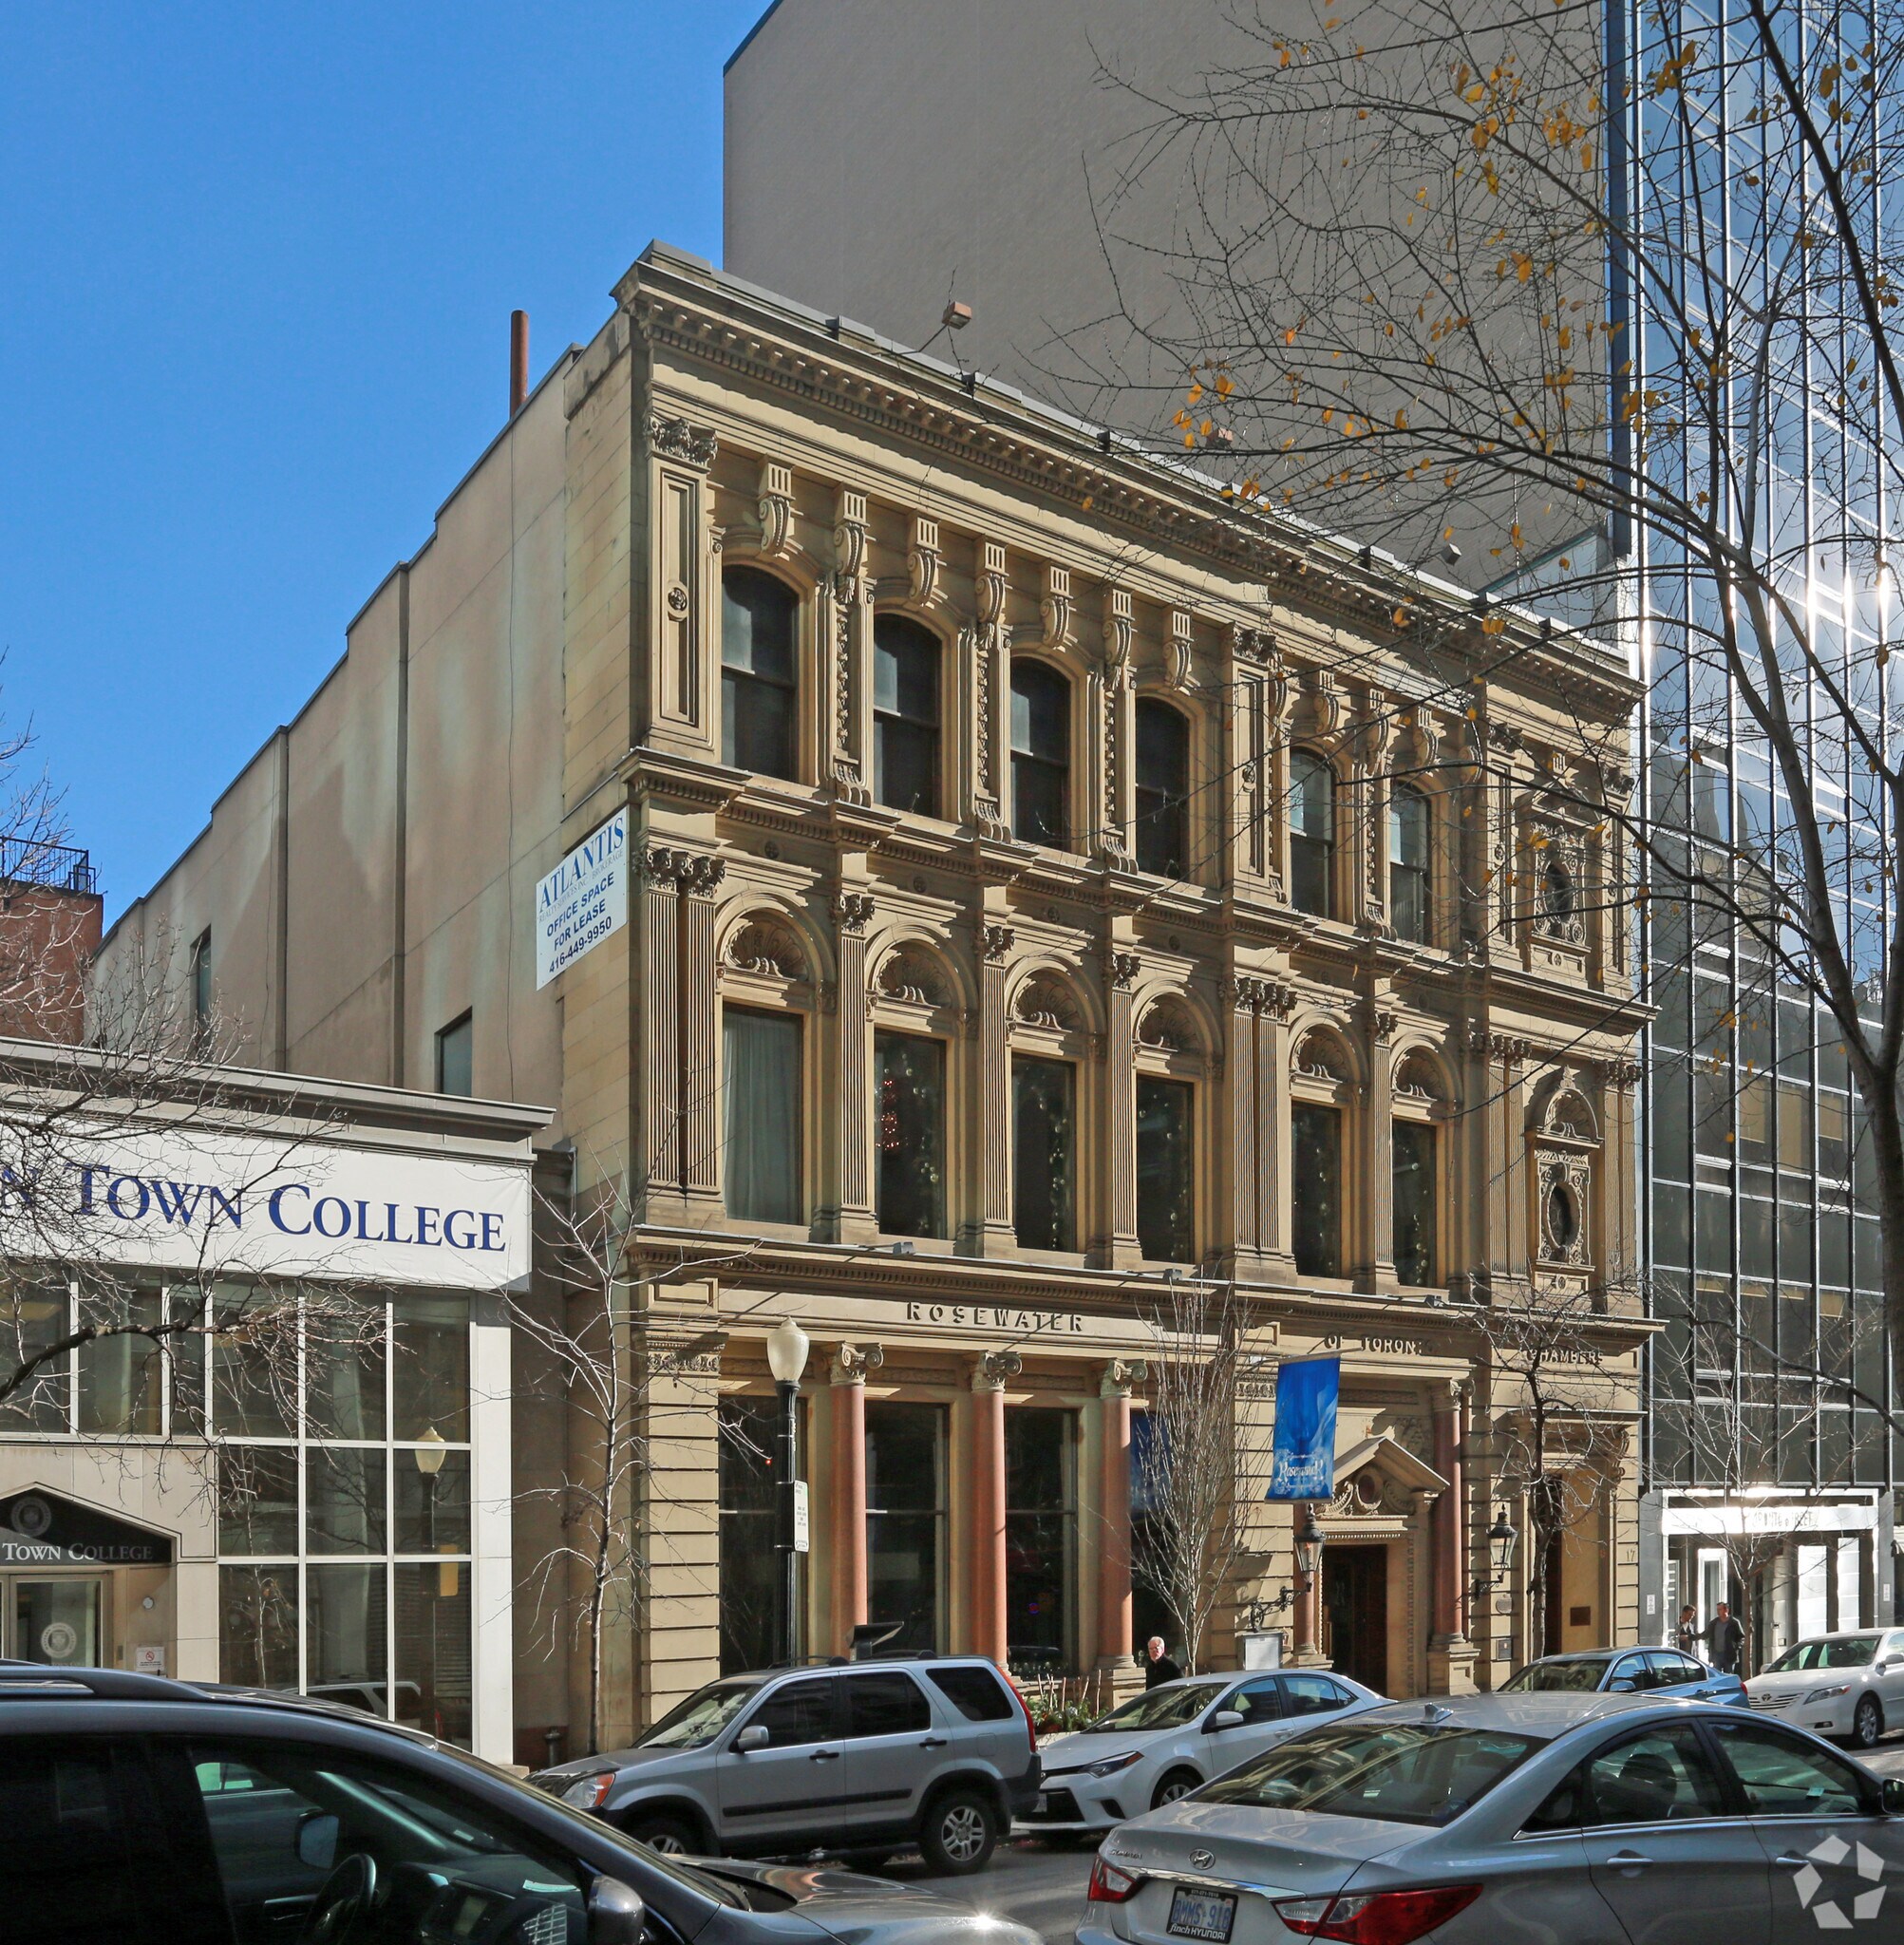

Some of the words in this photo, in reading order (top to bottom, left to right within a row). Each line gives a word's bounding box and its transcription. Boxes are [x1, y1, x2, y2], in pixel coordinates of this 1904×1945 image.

[538, 817, 624, 914] ATLANTIS
[546, 899, 578, 937] OFFICE
[581, 871, 614, 908] SPACE
[554, 926, 571, 952] FOR
[574, 898, 606, 935] LEASE
[549, 916, 613, 973] 416-449-9950
[63, 1161, 243, 1230] TOWN
[268, 1183, 506, 1252] COLLEGE
[906, 1301, 1083, 1332] ROSEWATER
[1526, 1348, 1604, 1366] CHAMBERS
[2, 1542, 61, 1560] TOWN
[67, 1542, 153, 1560] COLLEGE
[1626, 1548, 1636, 1562] 17
[1168, 1922, 1190, 1934] finch
[1190, 1925, 1226, 1940] HYUNDAI
